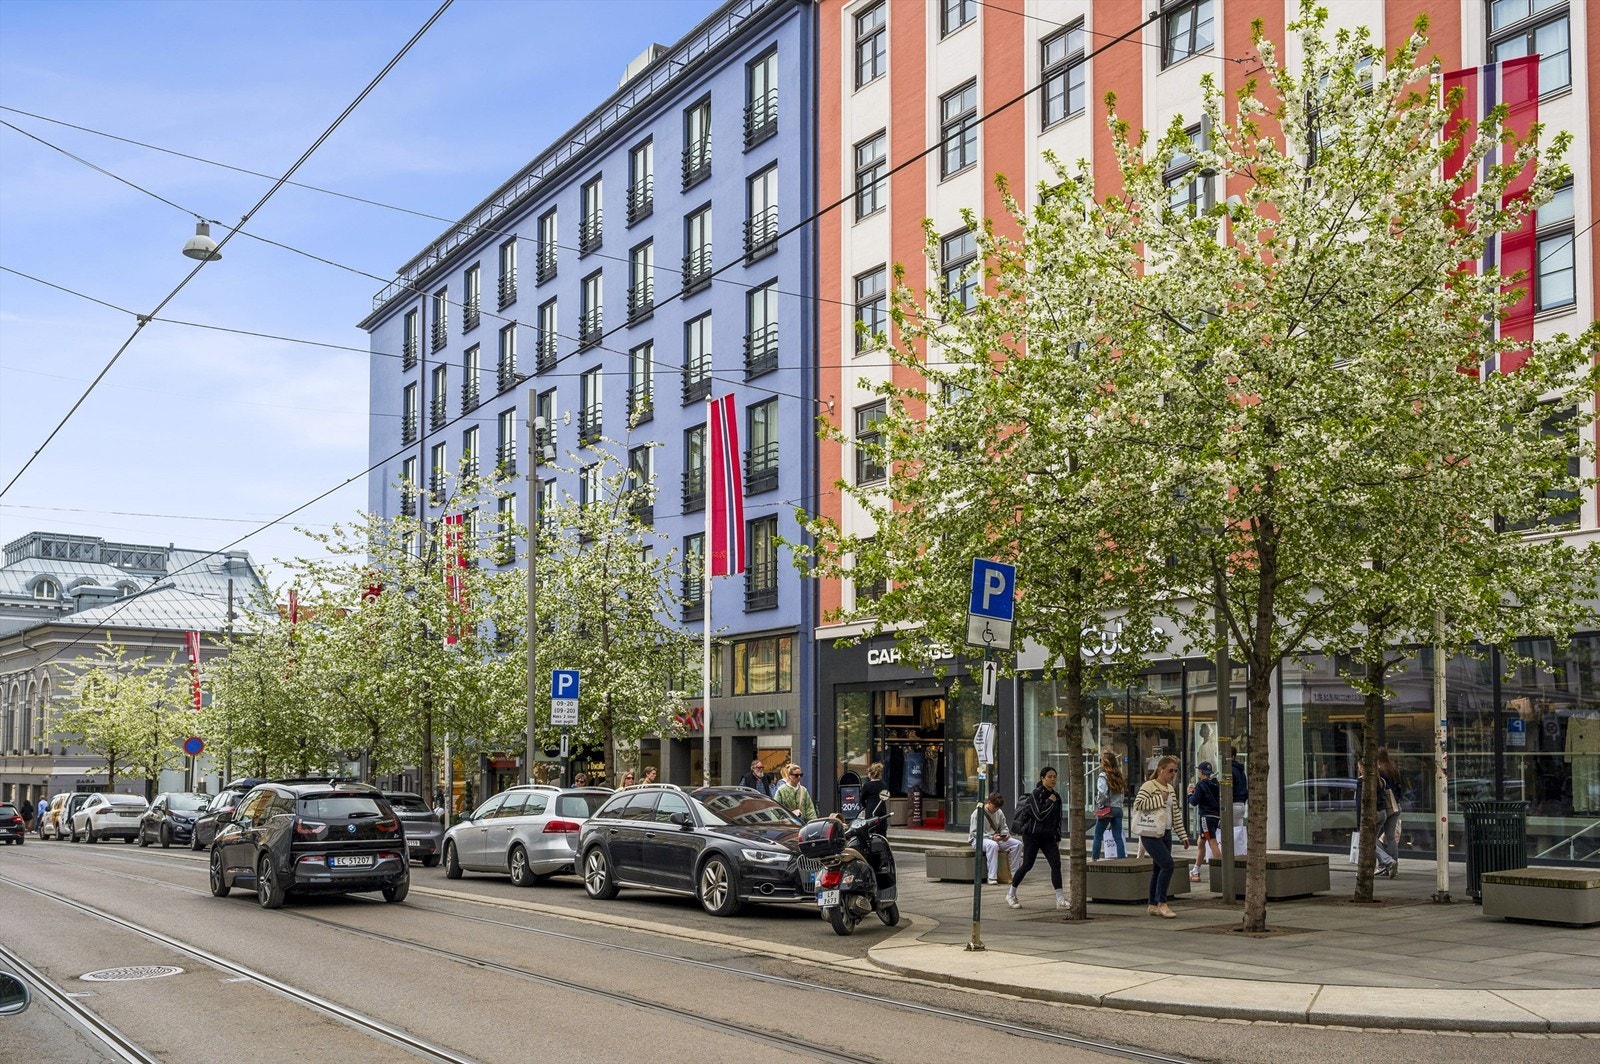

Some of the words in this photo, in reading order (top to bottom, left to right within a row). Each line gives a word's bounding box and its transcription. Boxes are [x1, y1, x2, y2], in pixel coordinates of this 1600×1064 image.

[982, 568, 1006, 610] P
[558, 673, 573, 696] P
[337, 857, 346, 865] EC
[349, 856, 370, 864] 51207
